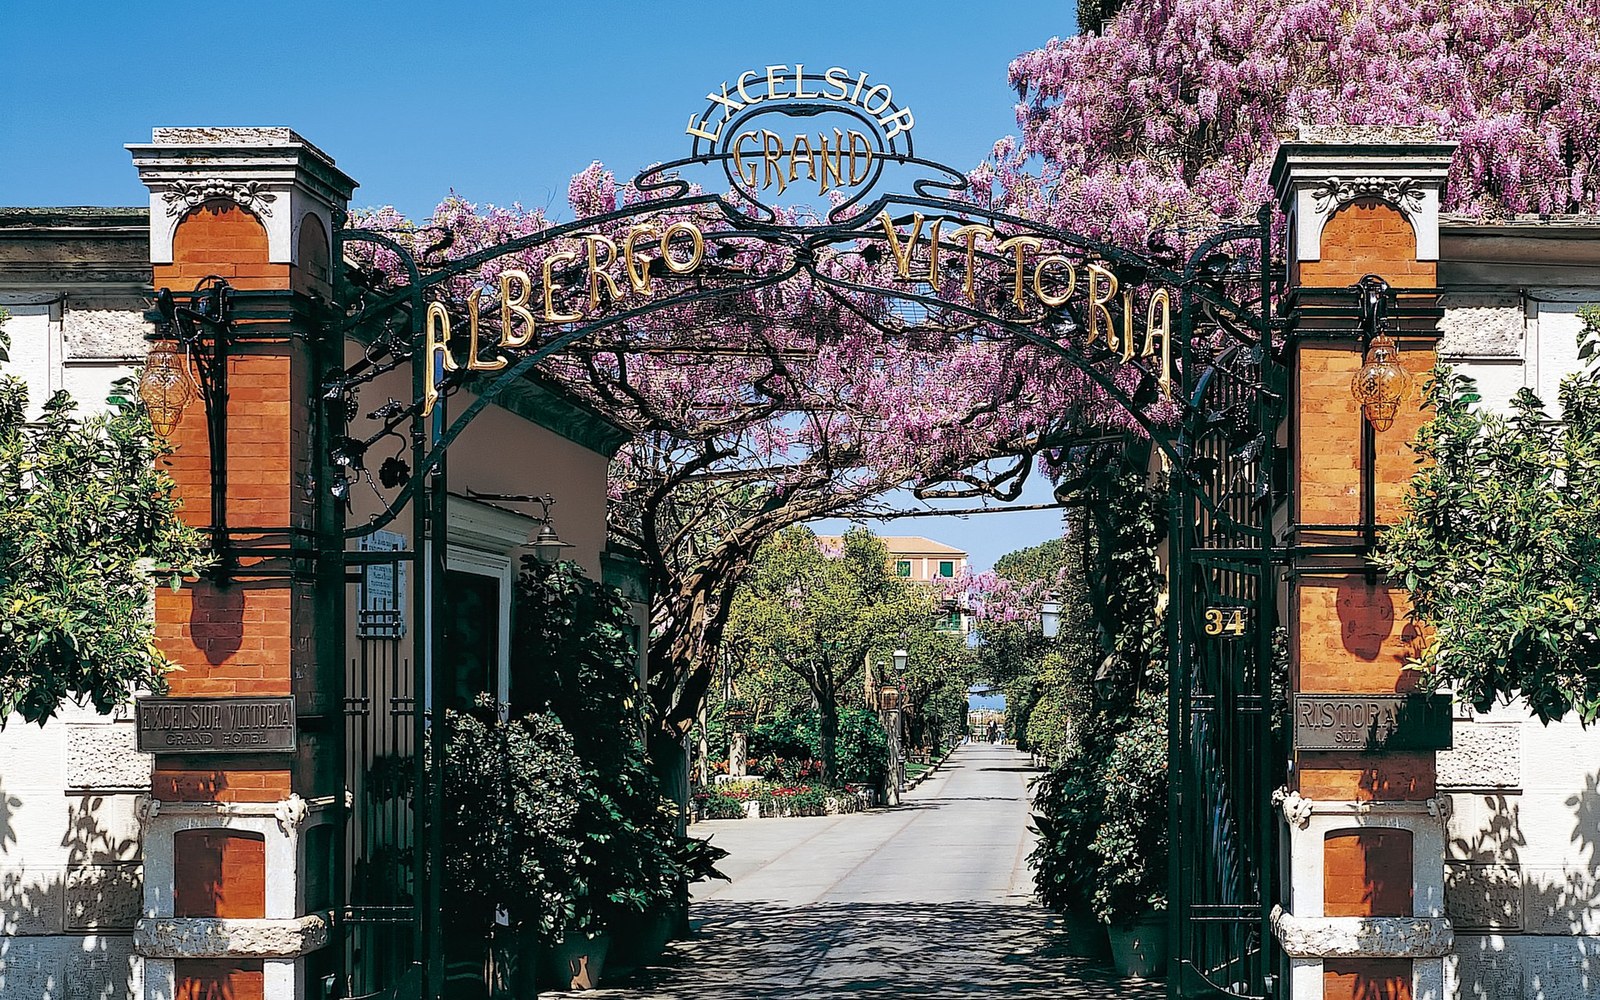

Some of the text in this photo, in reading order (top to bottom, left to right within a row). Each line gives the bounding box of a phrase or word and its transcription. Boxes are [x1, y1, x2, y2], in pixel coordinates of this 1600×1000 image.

[685, 63, 915, 143] EXCELSIOR
[733, 127, 873, 196] GRAND
[420, 210, 1171, 418] ALBERGO VITTORIA
[1205, 609, 1245, 636] 34
[141, 703, 293, 731] EXCELSIOR VITTORIA
[166, 732, 268, 745] GRAND HOTEL
[1335, 730, 1361, 743] SUL
